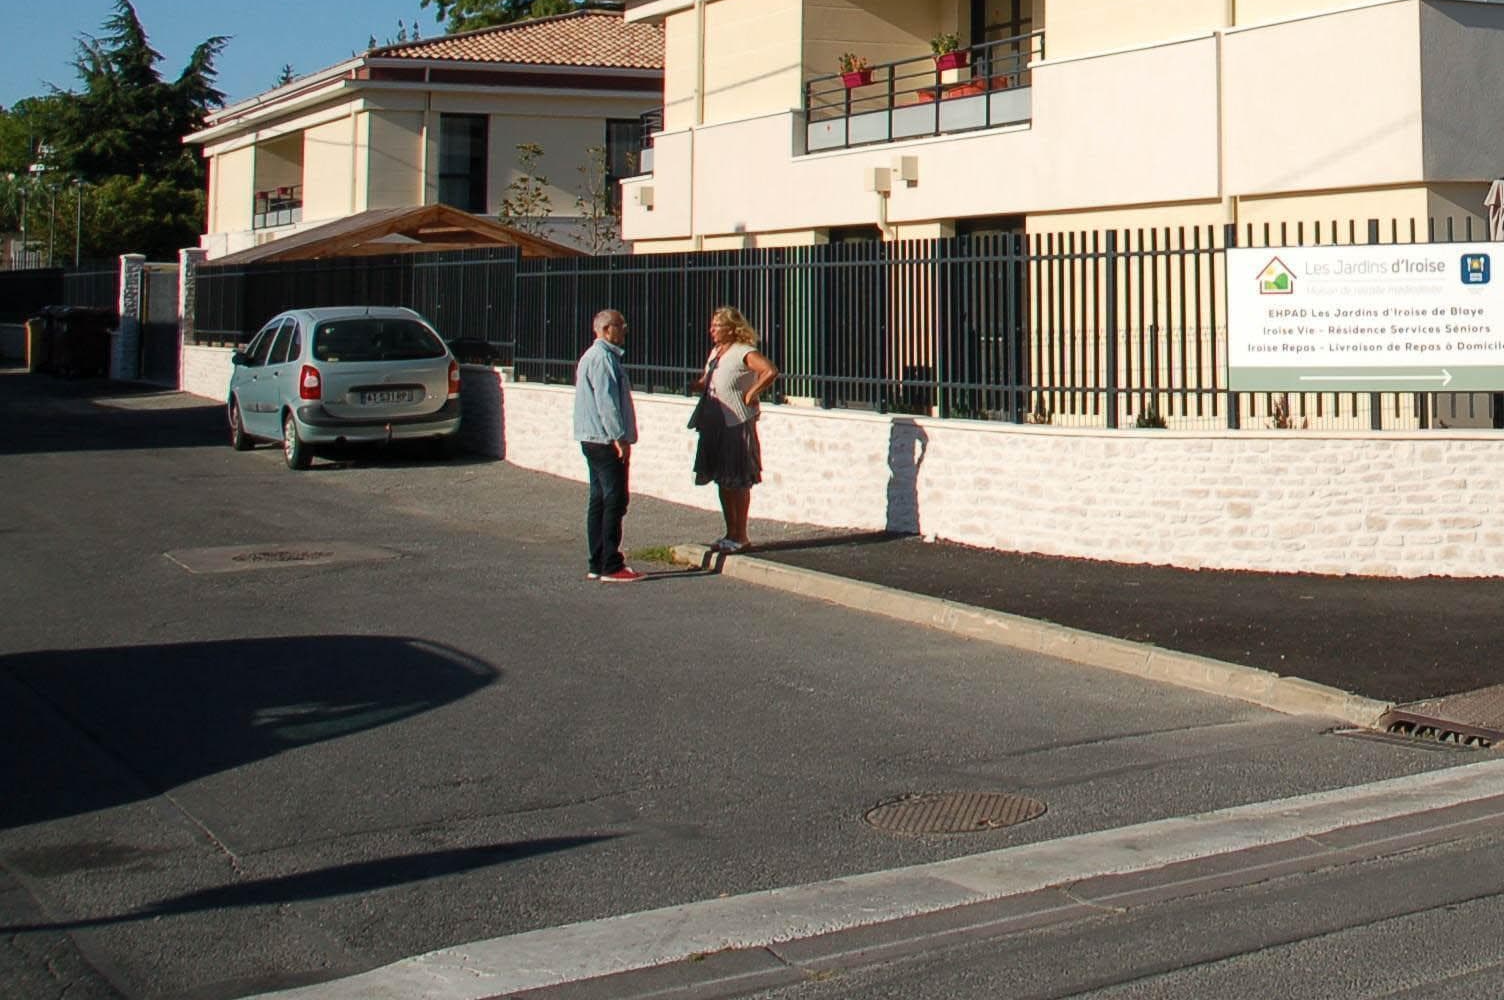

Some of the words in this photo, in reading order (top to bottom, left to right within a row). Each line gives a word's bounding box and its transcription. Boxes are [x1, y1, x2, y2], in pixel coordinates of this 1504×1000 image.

[1305, 261, 1329, 275] Les
[1334, 259, 1388, 275] Jardins
[1268, 308, 1307, 318] EHPAD
[1311, 308, 1330, 318] Les
[1334, 308, 1378, 318] Jardins
[1432, 307, 1446, 316] de
[1450, 306, 1484, 318] Blaye
[1263, 326, 1294, 336] Iroise
[1297, 325, 1315, 335] Vie
[1390, 324, 1441, 334] Services
[1248, 343, 1278, 352] Iroise
[1282, 343, 1316, 354] Repas
[1329, 342, 1383, 353] Livraison
[1387, 342, 1401, 352] de
[1405, 341, 1441, 353] Repas
